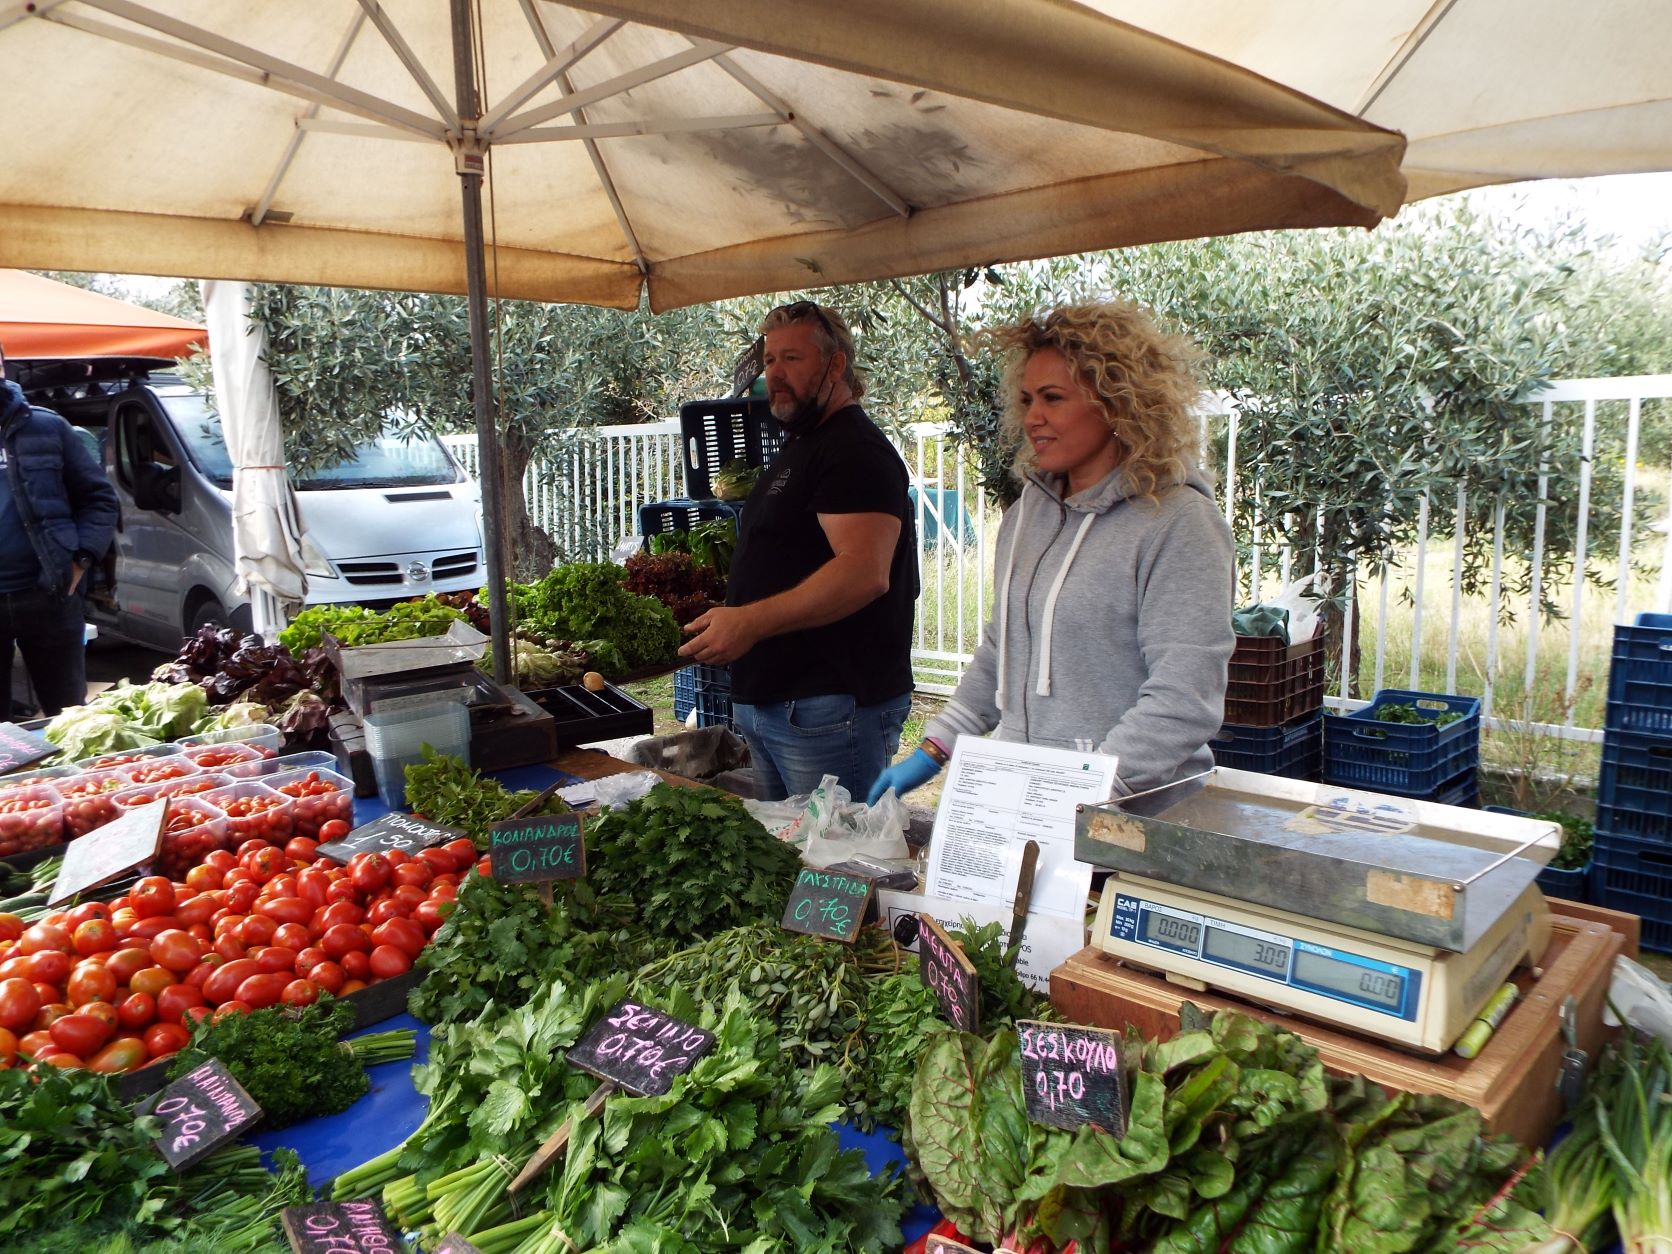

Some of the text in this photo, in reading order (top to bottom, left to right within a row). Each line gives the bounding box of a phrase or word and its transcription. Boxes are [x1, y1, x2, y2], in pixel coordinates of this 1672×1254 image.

[512, 844, 576, 872] 0,70€
[1158, 918, 1199, 944] 0.000
[1253, 943, 1288, 969] 3.00
[1358, 972, 1399, 999] 0.00
[1023, 1028, 1117, 1073] ΣΕΣΚΟΥΛΟ
